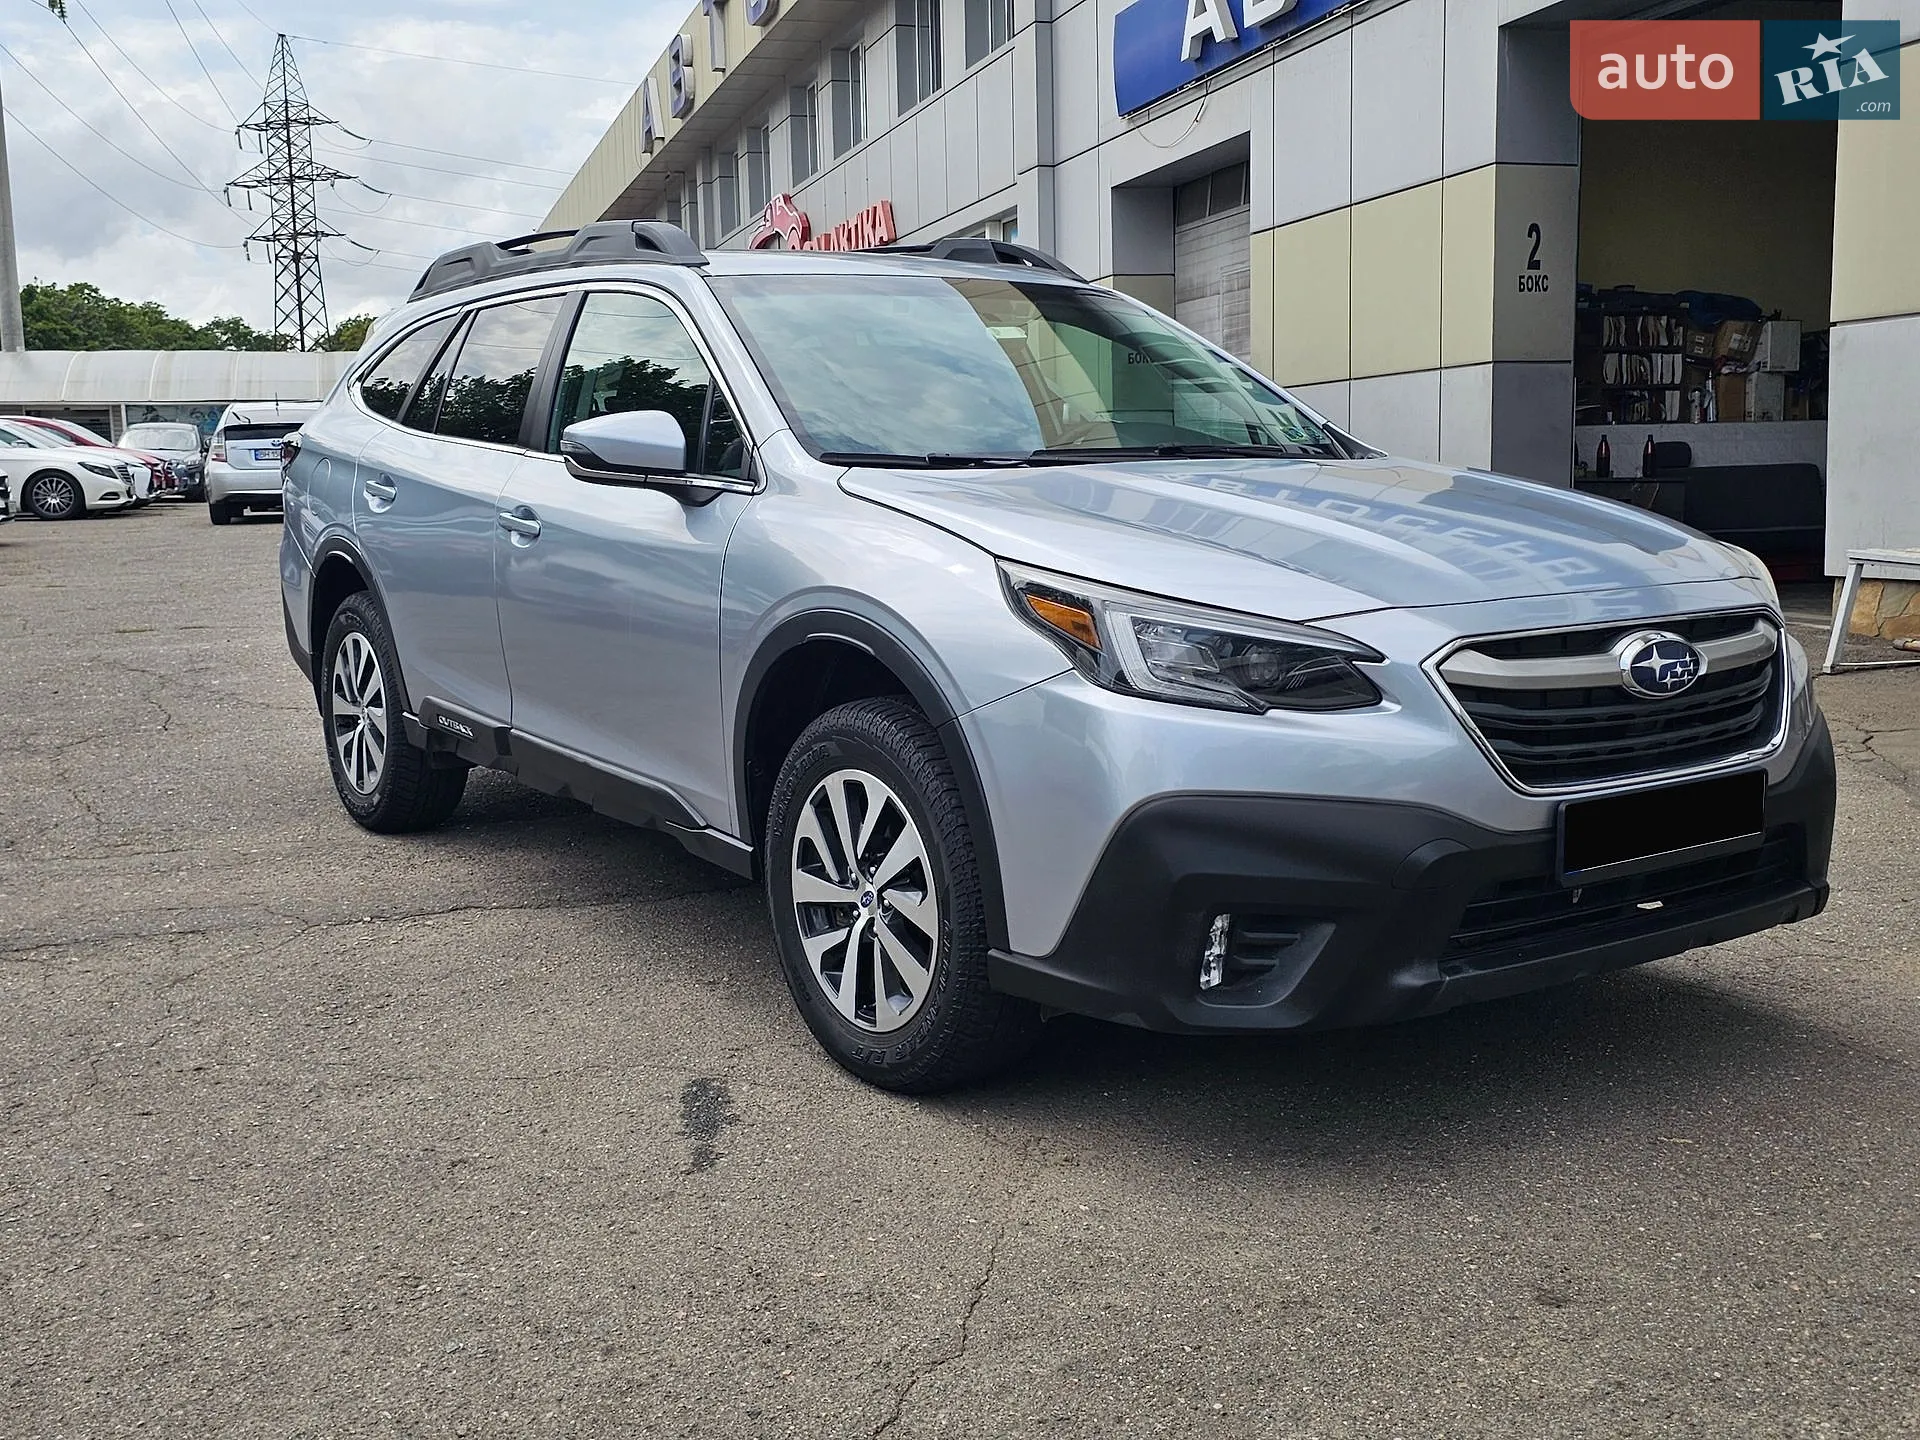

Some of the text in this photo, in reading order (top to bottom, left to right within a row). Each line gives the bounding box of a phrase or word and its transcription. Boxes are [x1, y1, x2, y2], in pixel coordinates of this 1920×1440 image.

[641, 0, 780, 153] АВТ
[1527, 223, 1541, 270] 2
[1519, 275, 1549, 292] БОКС
[1127, 352, 1153, 364] БОК
[438, 715, 474, 737] OUTBACK
